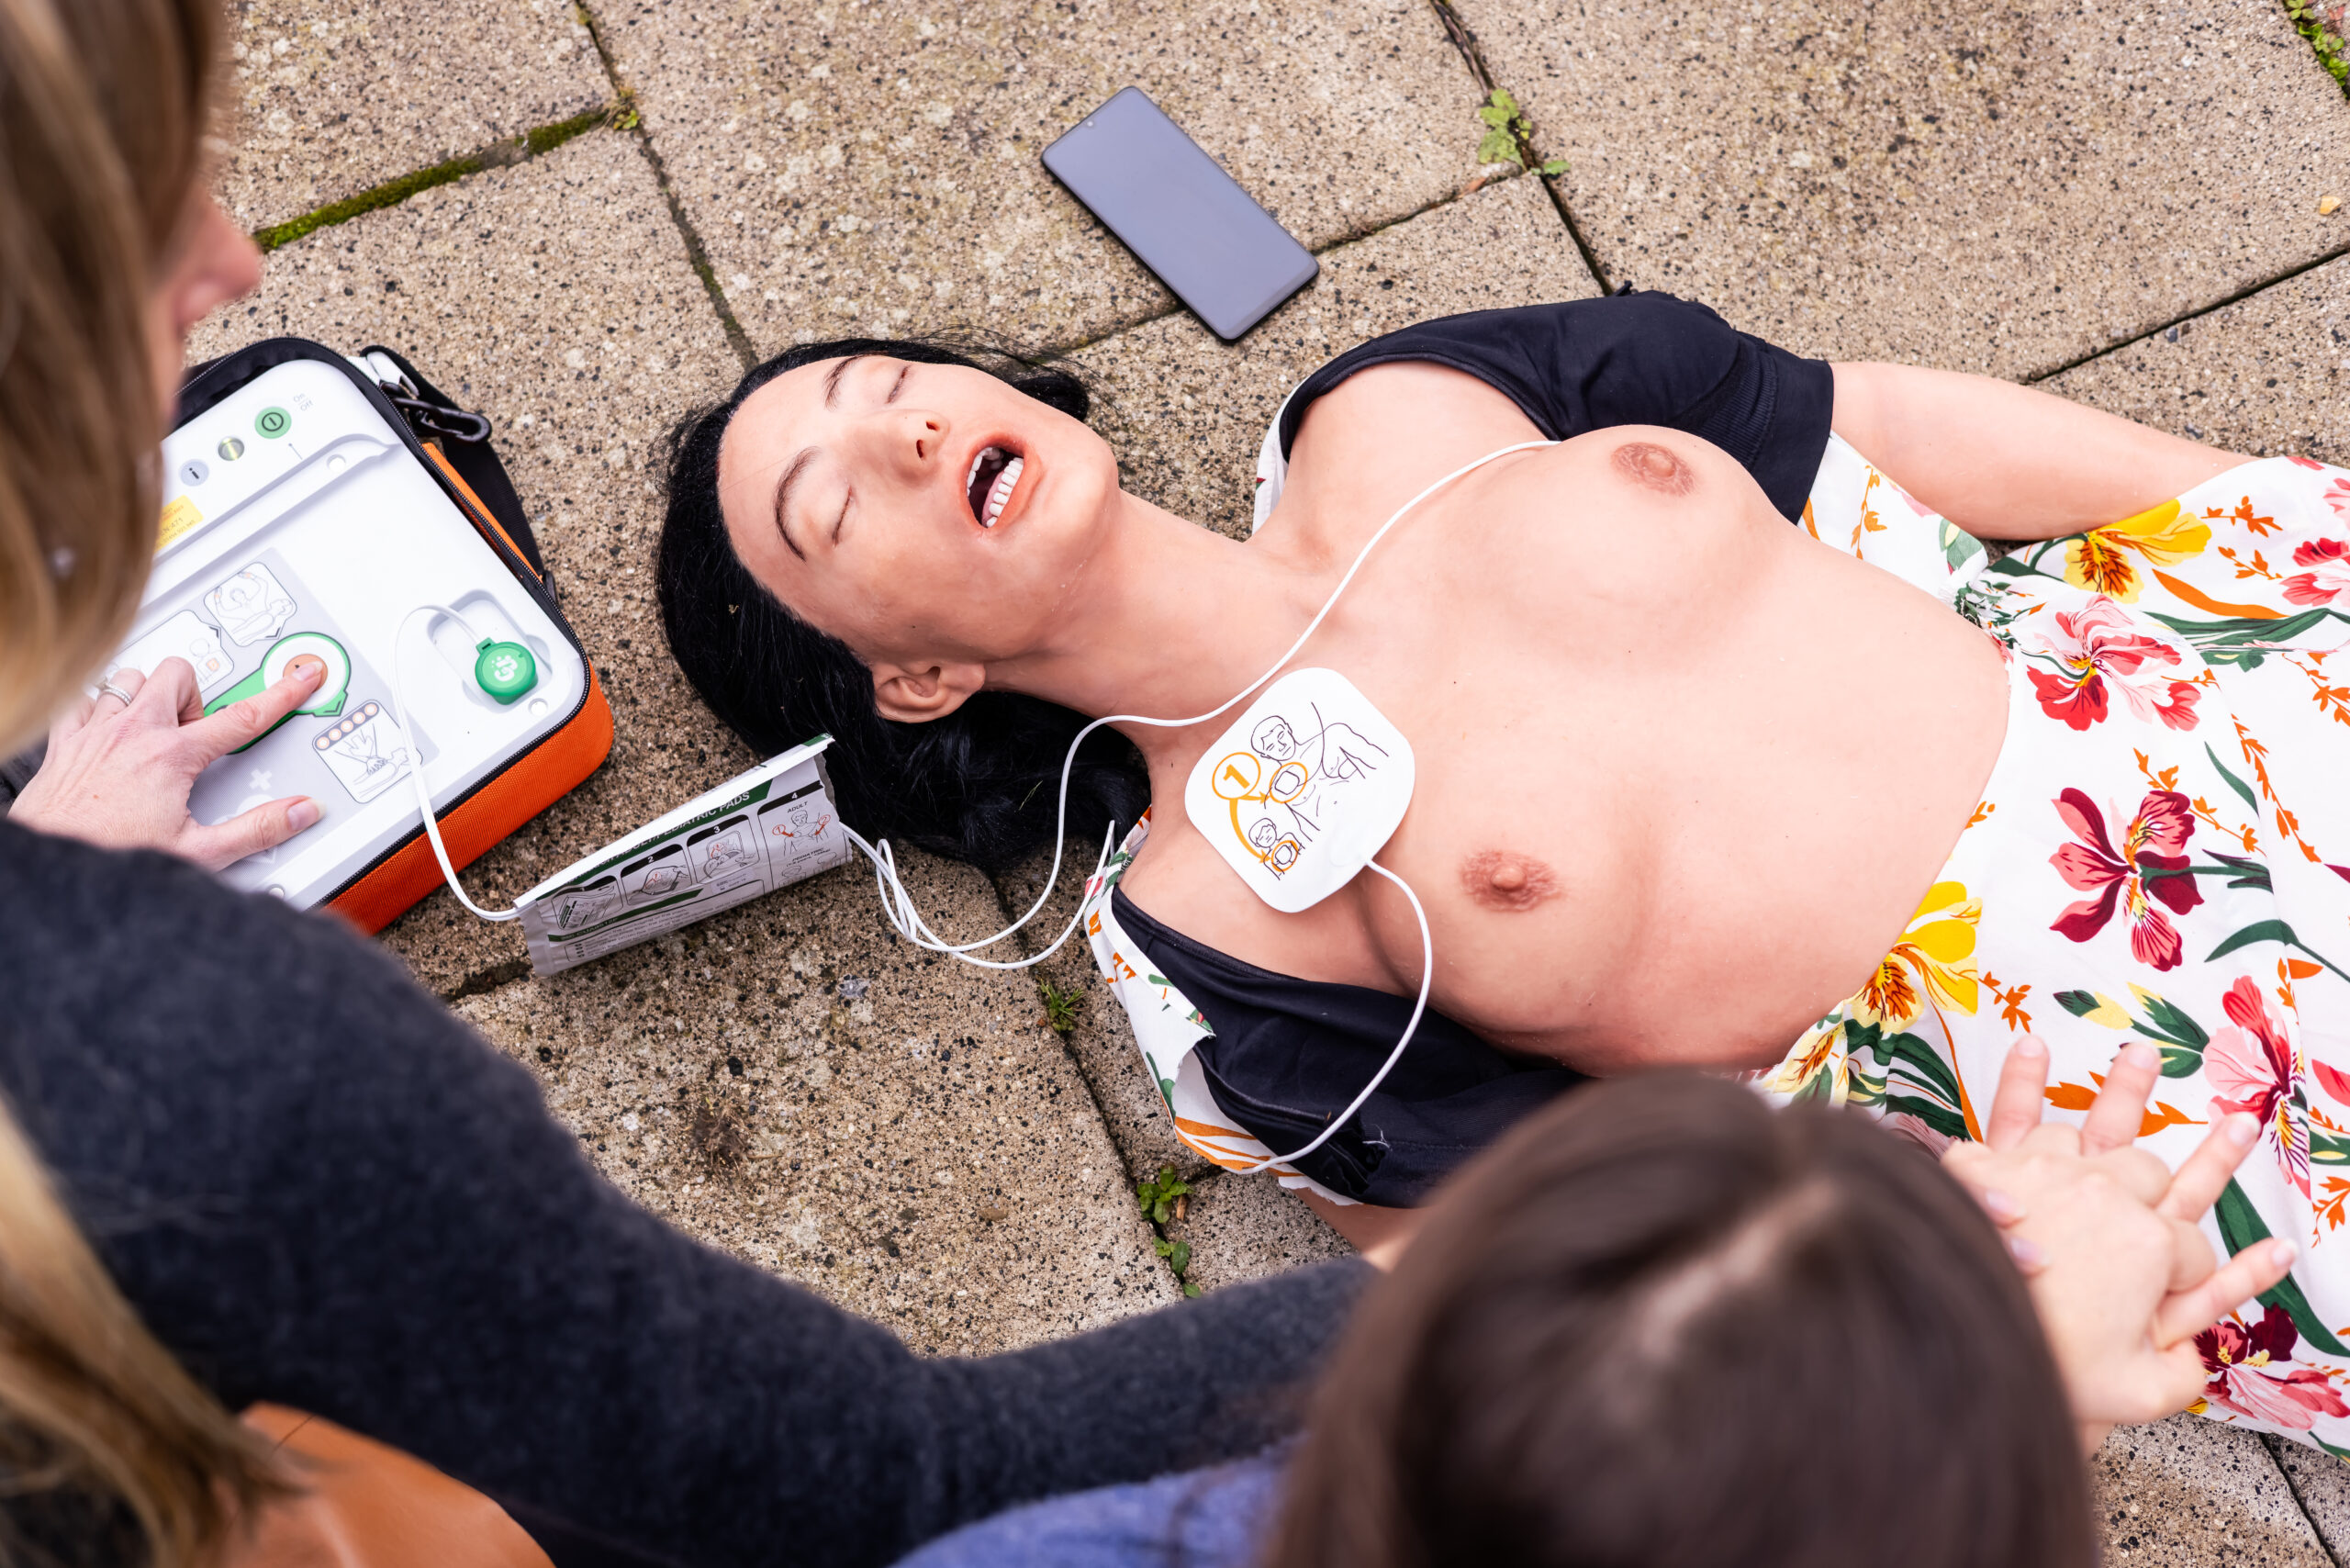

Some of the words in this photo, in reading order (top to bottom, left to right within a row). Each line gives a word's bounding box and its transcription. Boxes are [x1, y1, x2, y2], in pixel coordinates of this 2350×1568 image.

[293, 393, 305, 402] On
[300, 399, 313, 411] Off
[1223, 764, 1250, 790] 1
[719, 790, 750, 812] PADS
[787, 801, 808, 813] ADULT
